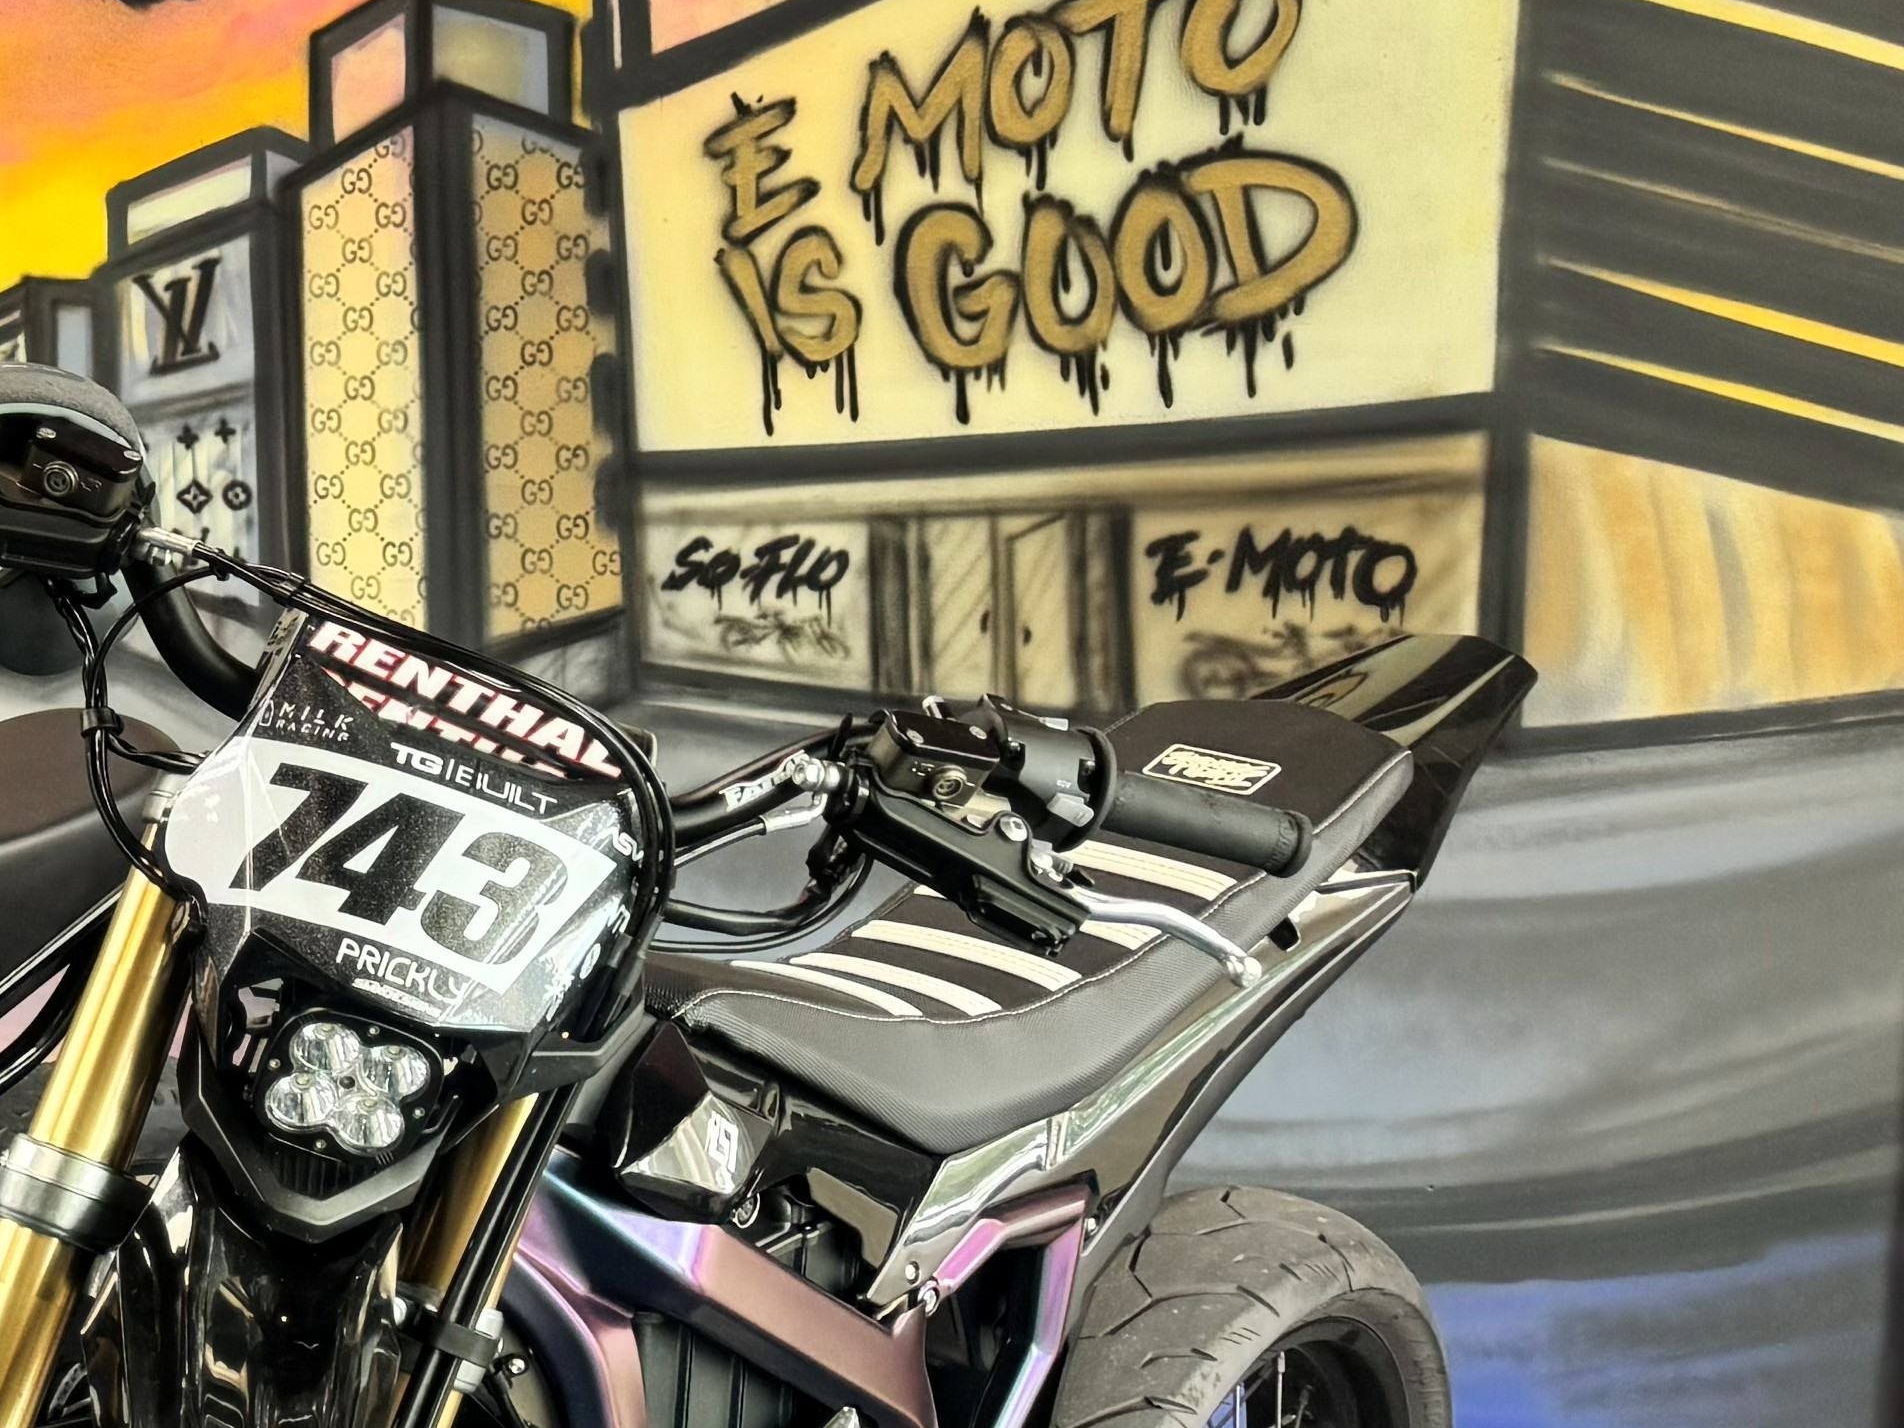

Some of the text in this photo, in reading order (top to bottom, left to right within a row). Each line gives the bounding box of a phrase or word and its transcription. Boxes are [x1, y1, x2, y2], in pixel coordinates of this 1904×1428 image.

[704, 93, 820, 246] E
[715, 132, 1360, 397] IS GOOD
[278, 702, 354, 731] MILK
[306, 619, 622, 780] RENTHAL
[231, 762, 569, 965] 743
[336, 937, 468, 1006] PRICKLY
